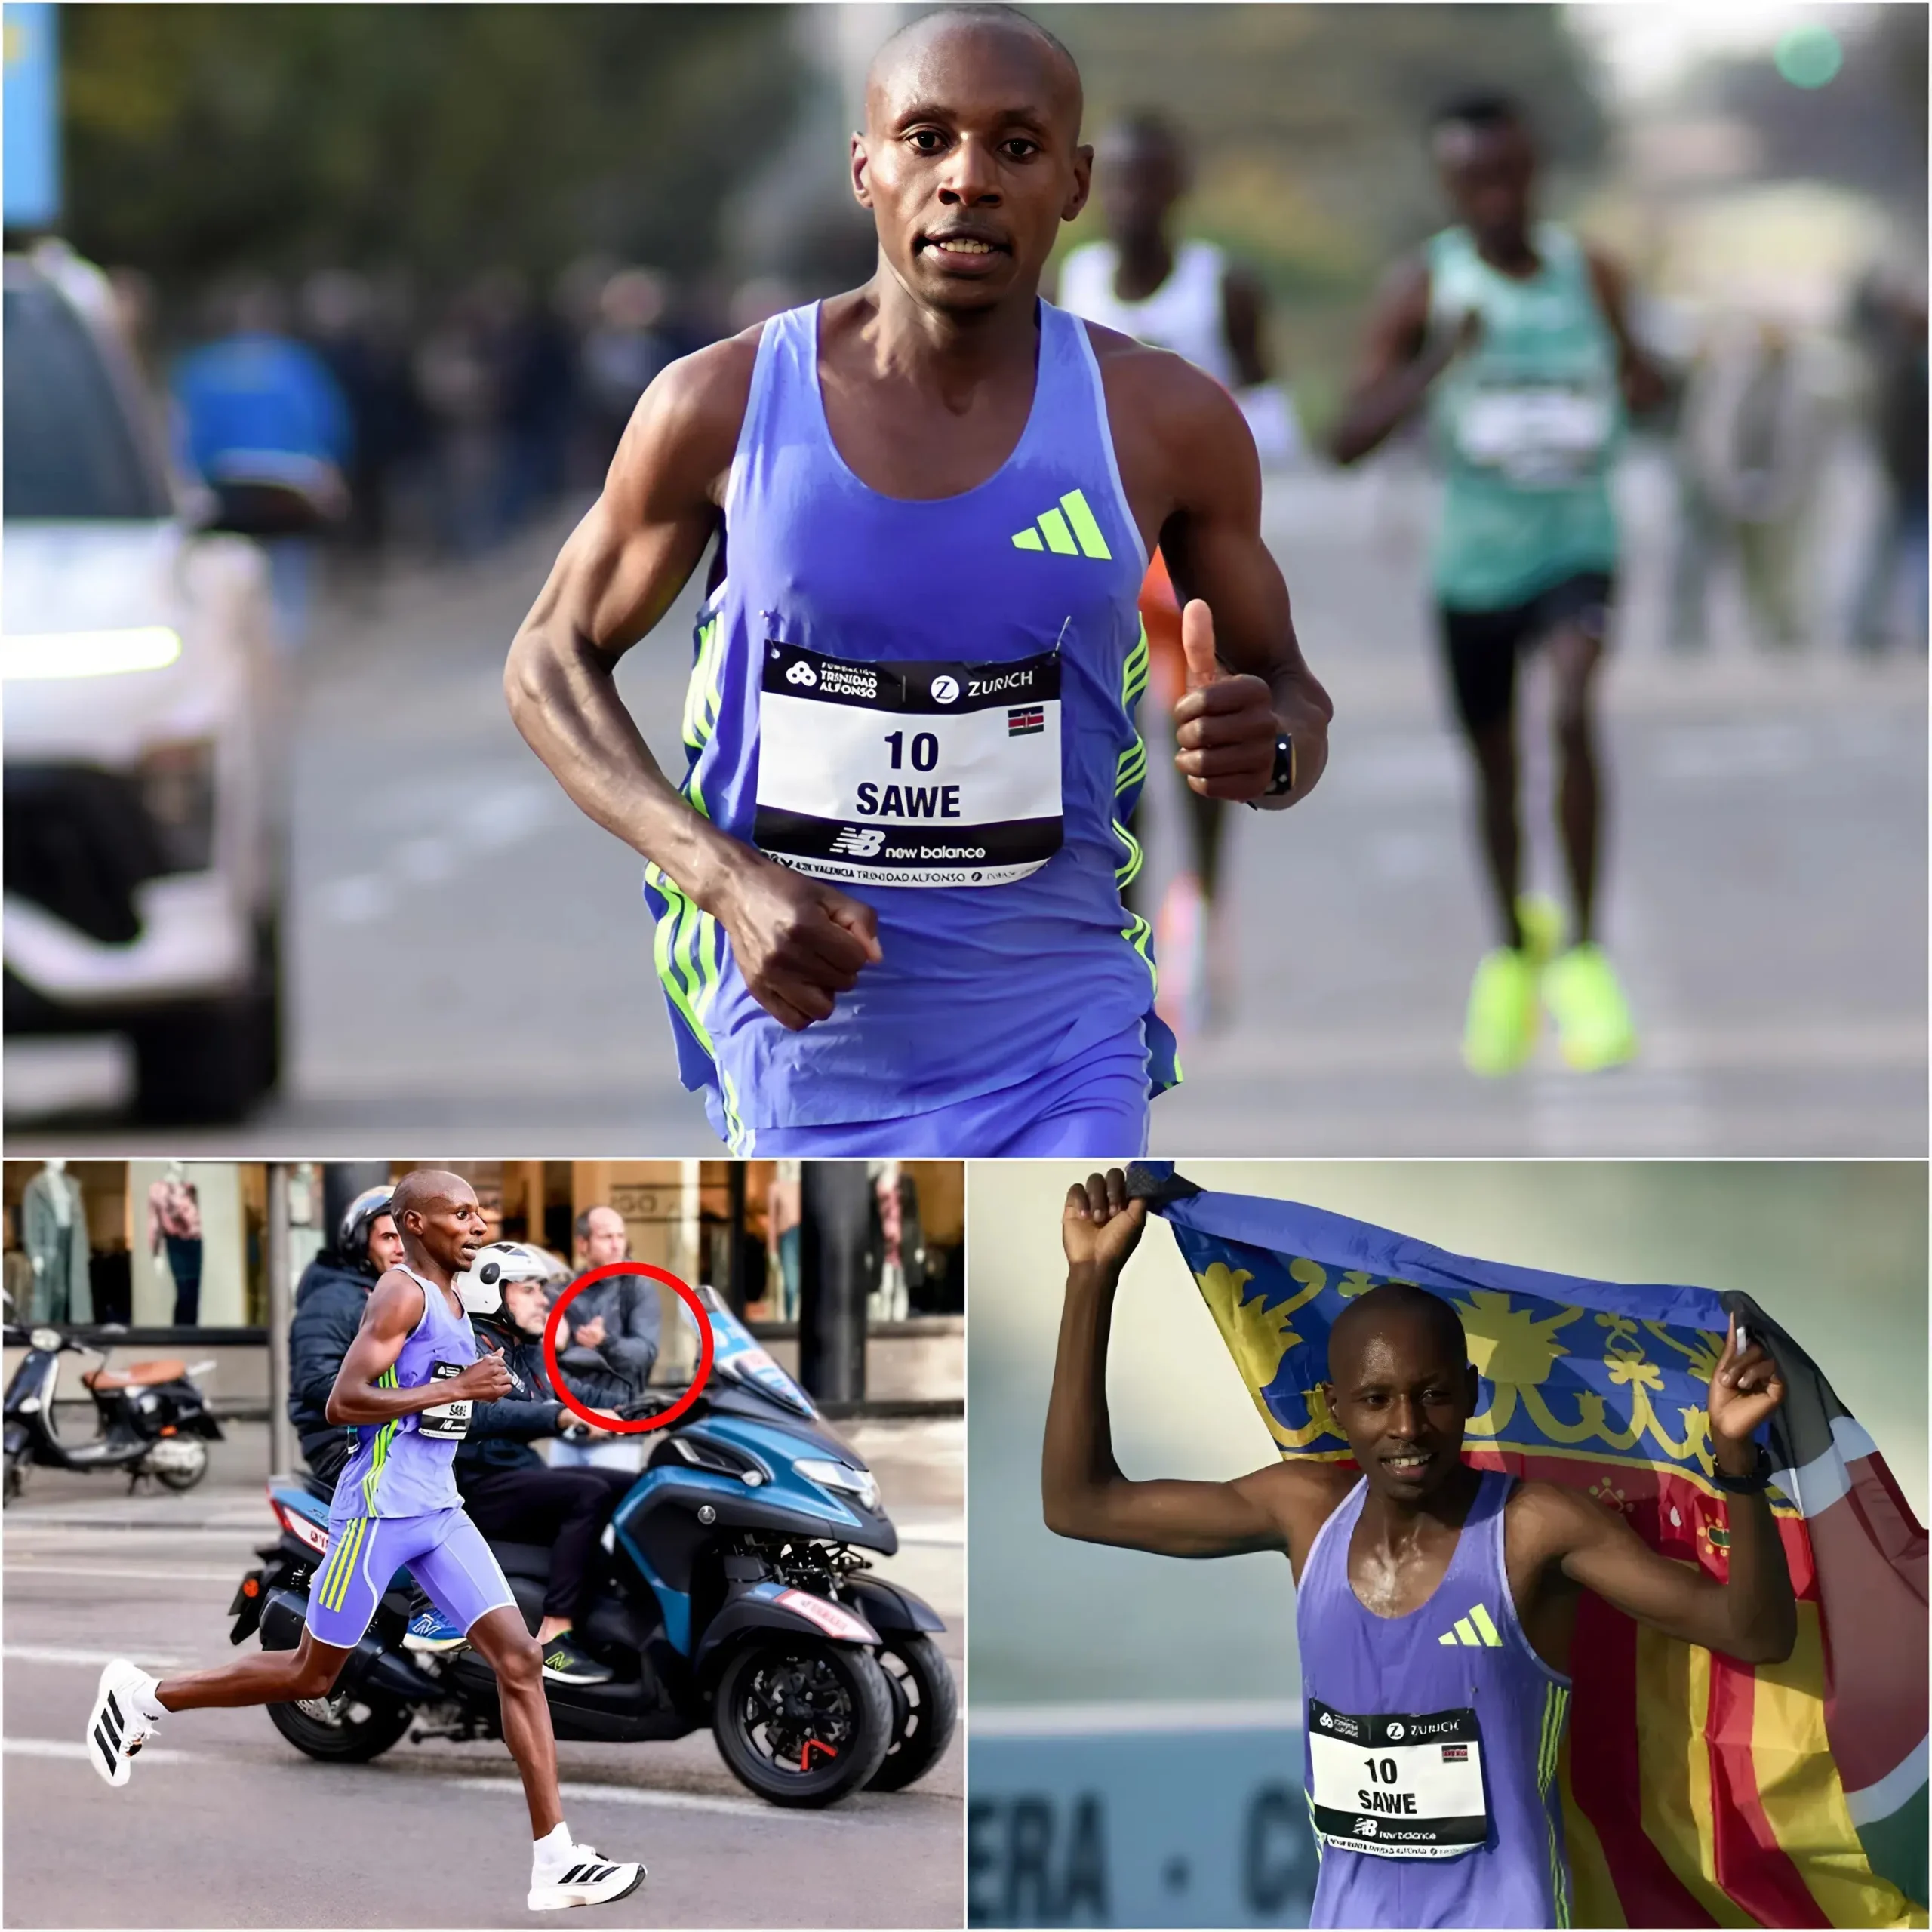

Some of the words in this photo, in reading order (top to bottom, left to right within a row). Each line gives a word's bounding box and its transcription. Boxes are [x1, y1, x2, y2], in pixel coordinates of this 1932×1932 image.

[820, 670, 878, 688] TRINIDAD
[820, 681, 877, 699] ALFONSO
[968, 670, 1033, 697] ZURICH
[884, 731, 939, 772] 10
[856, 782, 961, 818] SAWE
[1364, 1758, 1398, 1784] 10
[1358, 1789, 1417, 1814] SAWE
